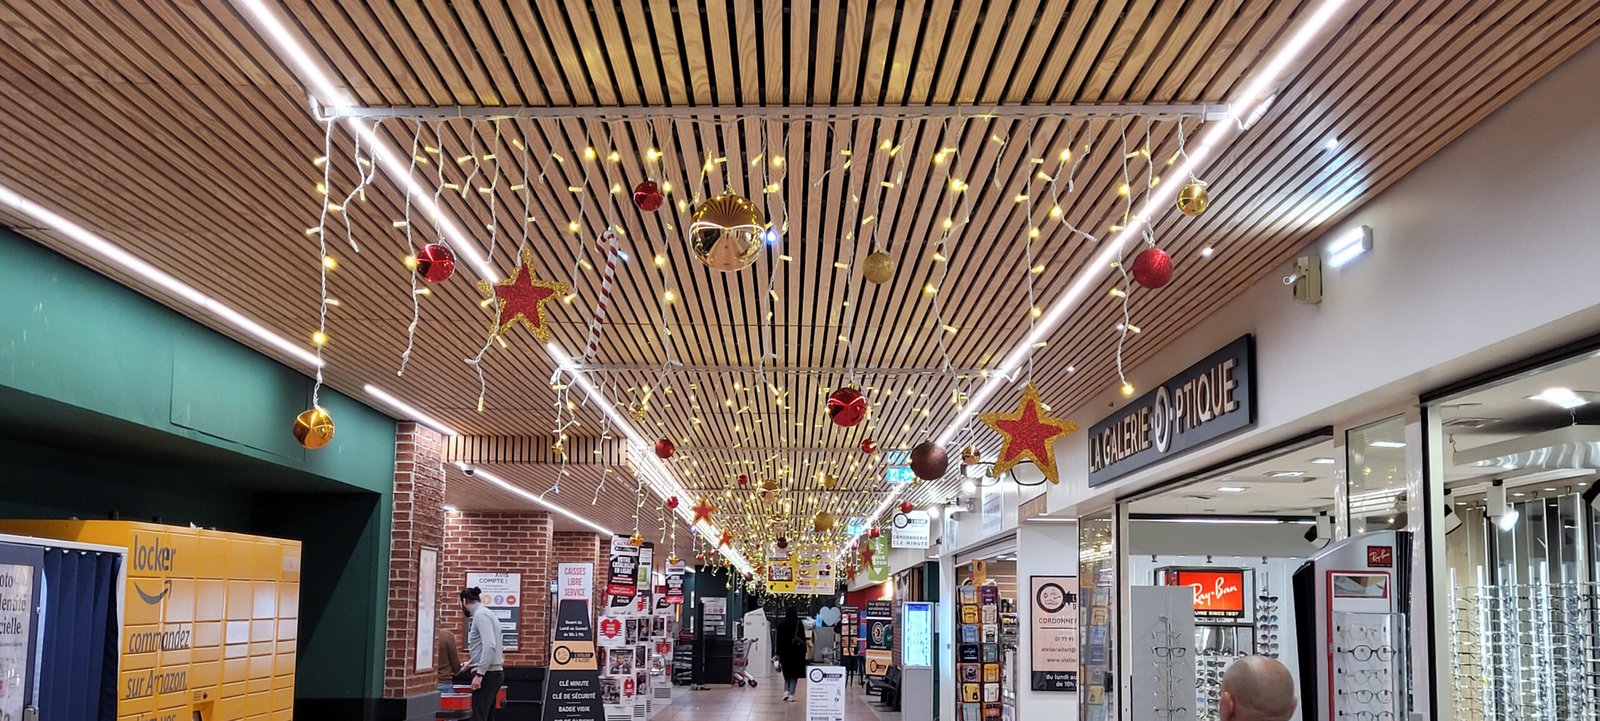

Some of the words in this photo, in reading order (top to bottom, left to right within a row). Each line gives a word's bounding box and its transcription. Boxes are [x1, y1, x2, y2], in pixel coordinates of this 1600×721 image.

[1089, 432, 1101, 473] LA
[1103, 406, 1151, 466] GALERIE
[133, 534, 176, 571] locker
[564, 567, 586, 575] CAISSES
[564, 588, 586, 596] SERVICE
[129, 624, 190, 653] commandez
[126, 677, 145, 699] sur
[559, 679, 569, 687] CLÉ
[552, 692, 562, 700] CLÉ
[571, 692, 596, 700] SÉCURITÉ
